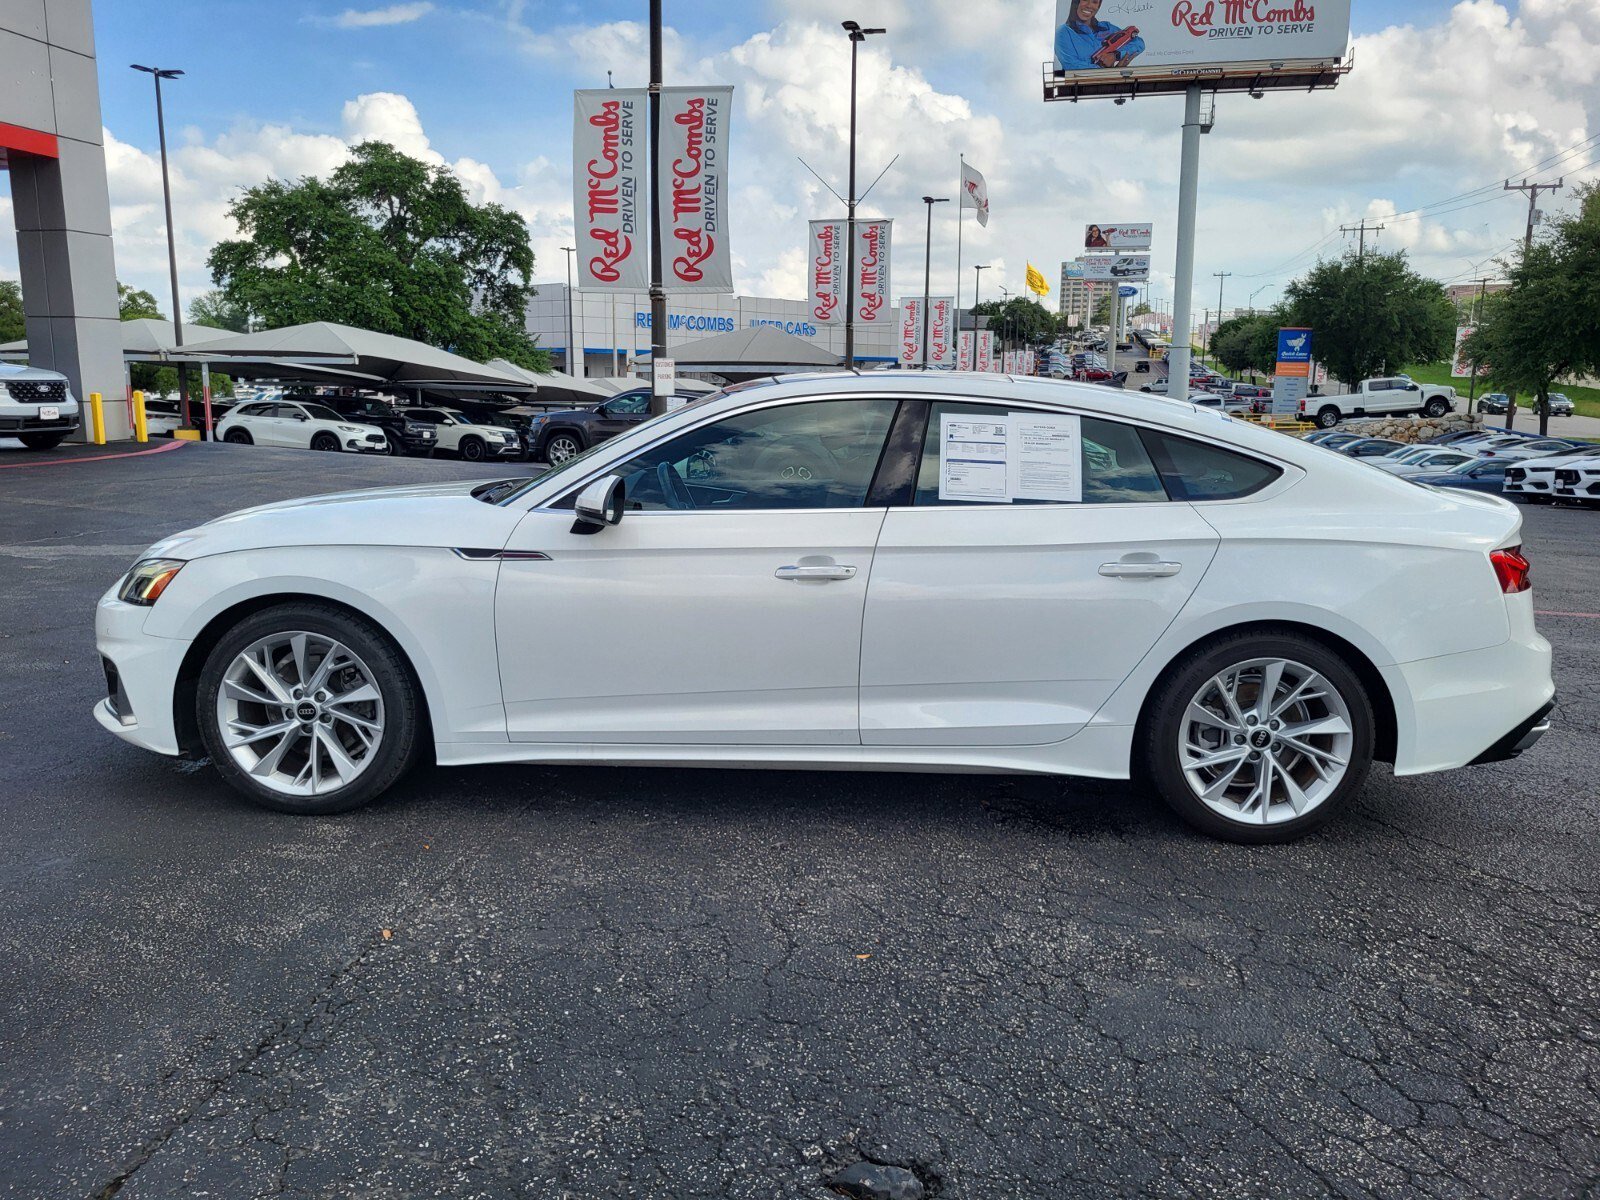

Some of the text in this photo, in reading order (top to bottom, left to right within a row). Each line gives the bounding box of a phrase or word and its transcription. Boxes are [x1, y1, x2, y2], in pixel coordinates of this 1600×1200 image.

[1171, 0, 1214, 36] Red
[1208, 23, 1314, 38] DRIVEN TO SERVE
[587, 100, 632, 282] Red McCombs
[621, 100, 634, 234] DRIVEN TO SERVE
[672, 97, 714, 282] Red McCombs
[704, 97, 718, 232] DRIVEN TO SERVE
[833, 225, 841, 250] SERVE
[833, 251, 840, 263] TO
[878, 251, 885, 263] TO
[814, 225, 838, 320] Red McCombs
[859, 225, 883, 320] Red McCombs
[636, 312, 652, 328] RE
[669, 314, 734, 331] McCOMBS
[786, 321, 817, 336] CARS
[902, 300, 918, 360] Red McCombs
[931, 300, 947, 361] Red McCombs
